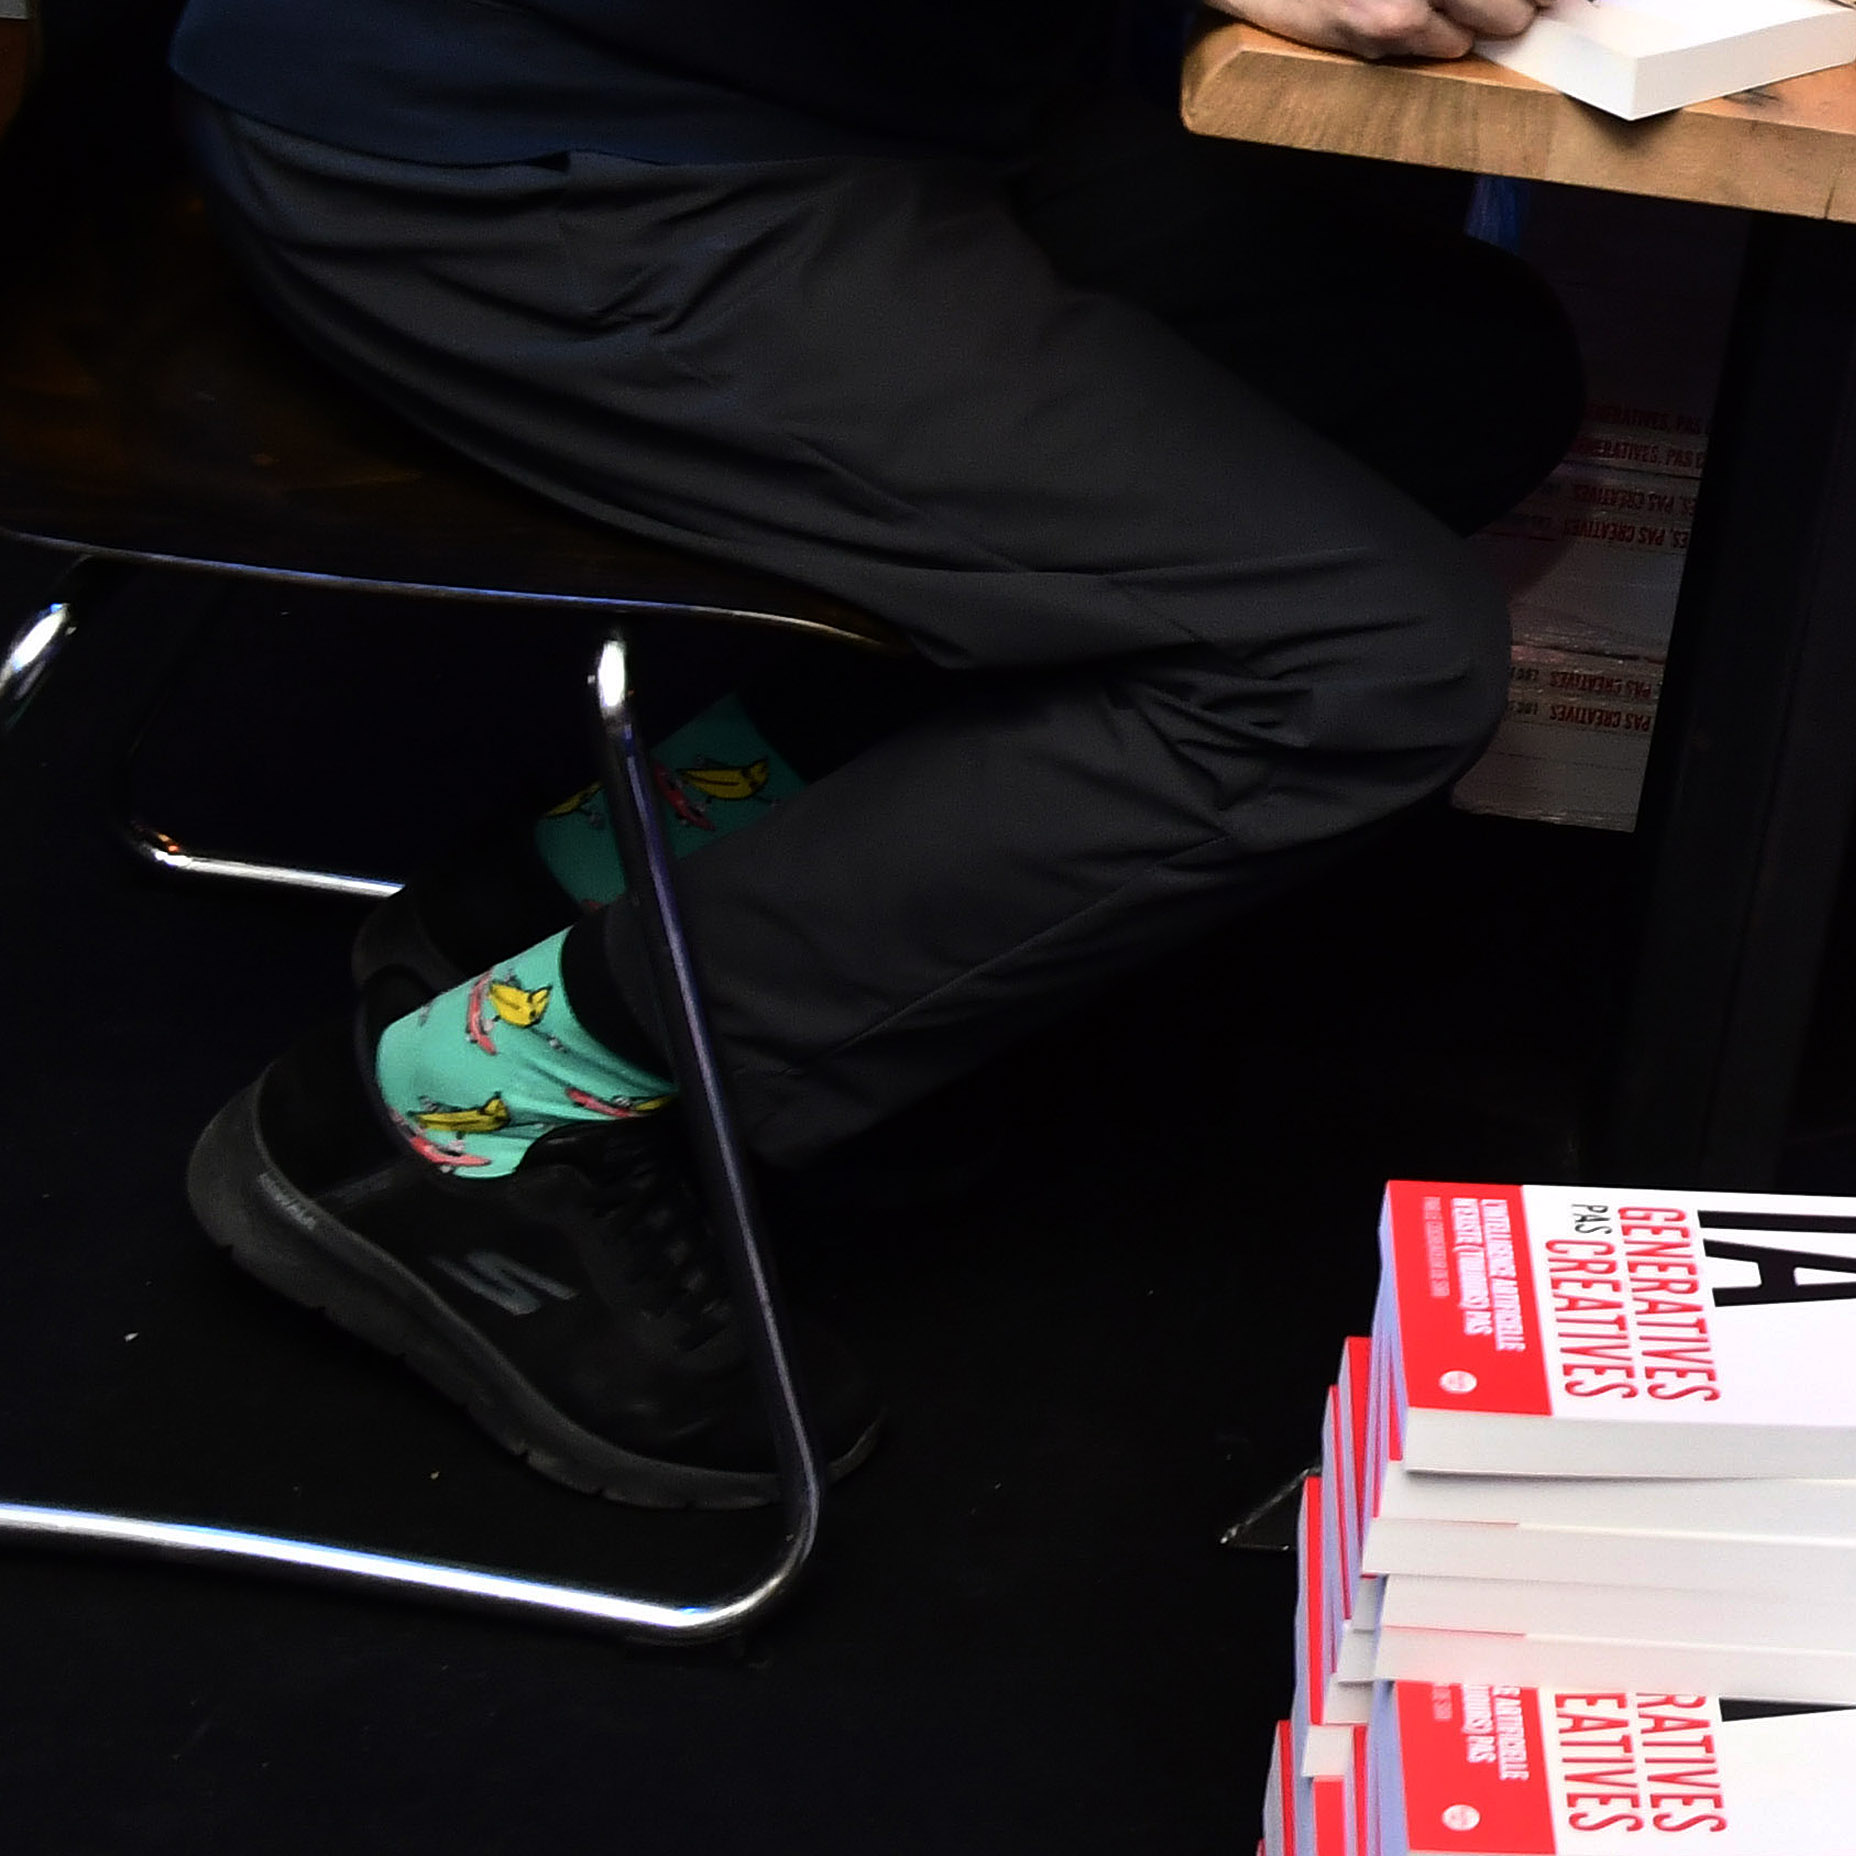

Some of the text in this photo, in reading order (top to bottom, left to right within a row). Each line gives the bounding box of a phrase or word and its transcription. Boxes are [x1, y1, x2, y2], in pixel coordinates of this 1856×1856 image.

[1666, 447, 1693, 468] PAS
[1637, 525, 1666, 546] PAS
[1625, 679, 1652, 699] PAS
[1624, 712, 1652, 732] PAS
[1570, 1203, 1613, 1236] PAS
[1554, 1692, 1645, 1833] EATIVES
[1635, 1692, 1728, 1833] RATIVES
